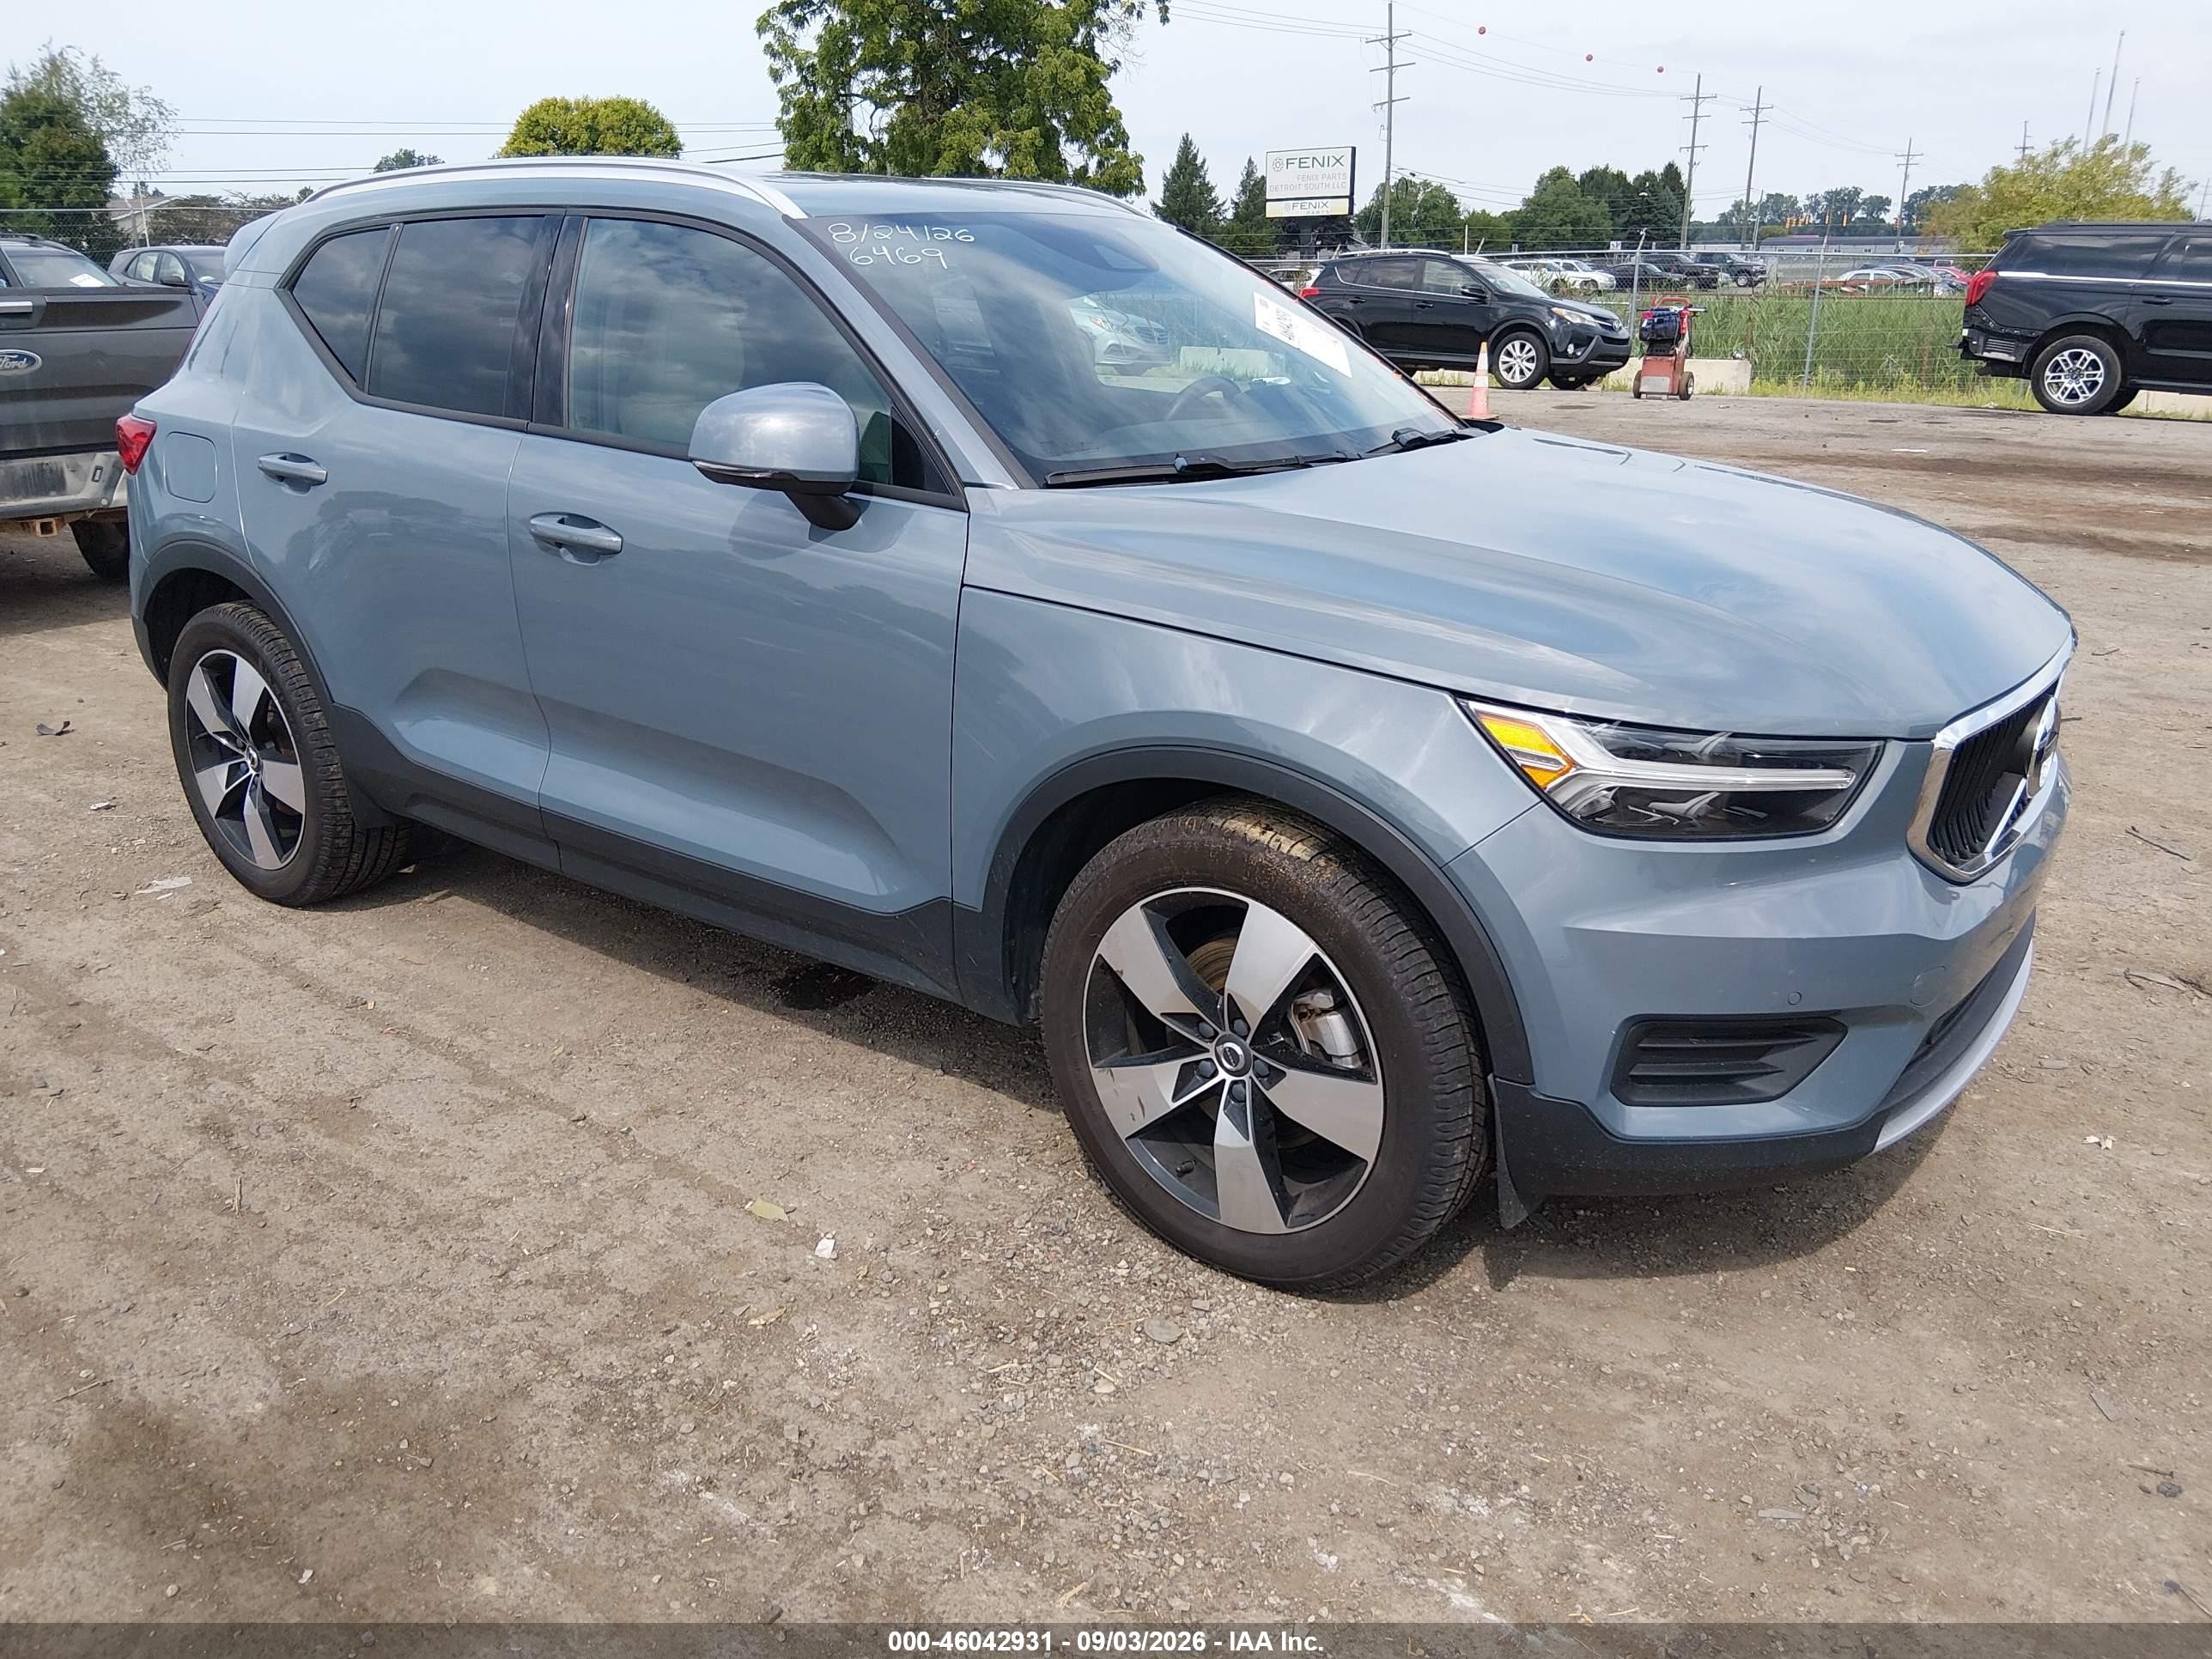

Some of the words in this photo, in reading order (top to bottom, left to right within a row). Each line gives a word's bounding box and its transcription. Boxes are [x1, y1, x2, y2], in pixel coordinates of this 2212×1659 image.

[1286, 155, 1345, 170] FENIX
[1270, 184, 1301, 192] DETROIT
[1292, 201, 1329, 210] FENIX
[849, 246, 947, 270] 6469
